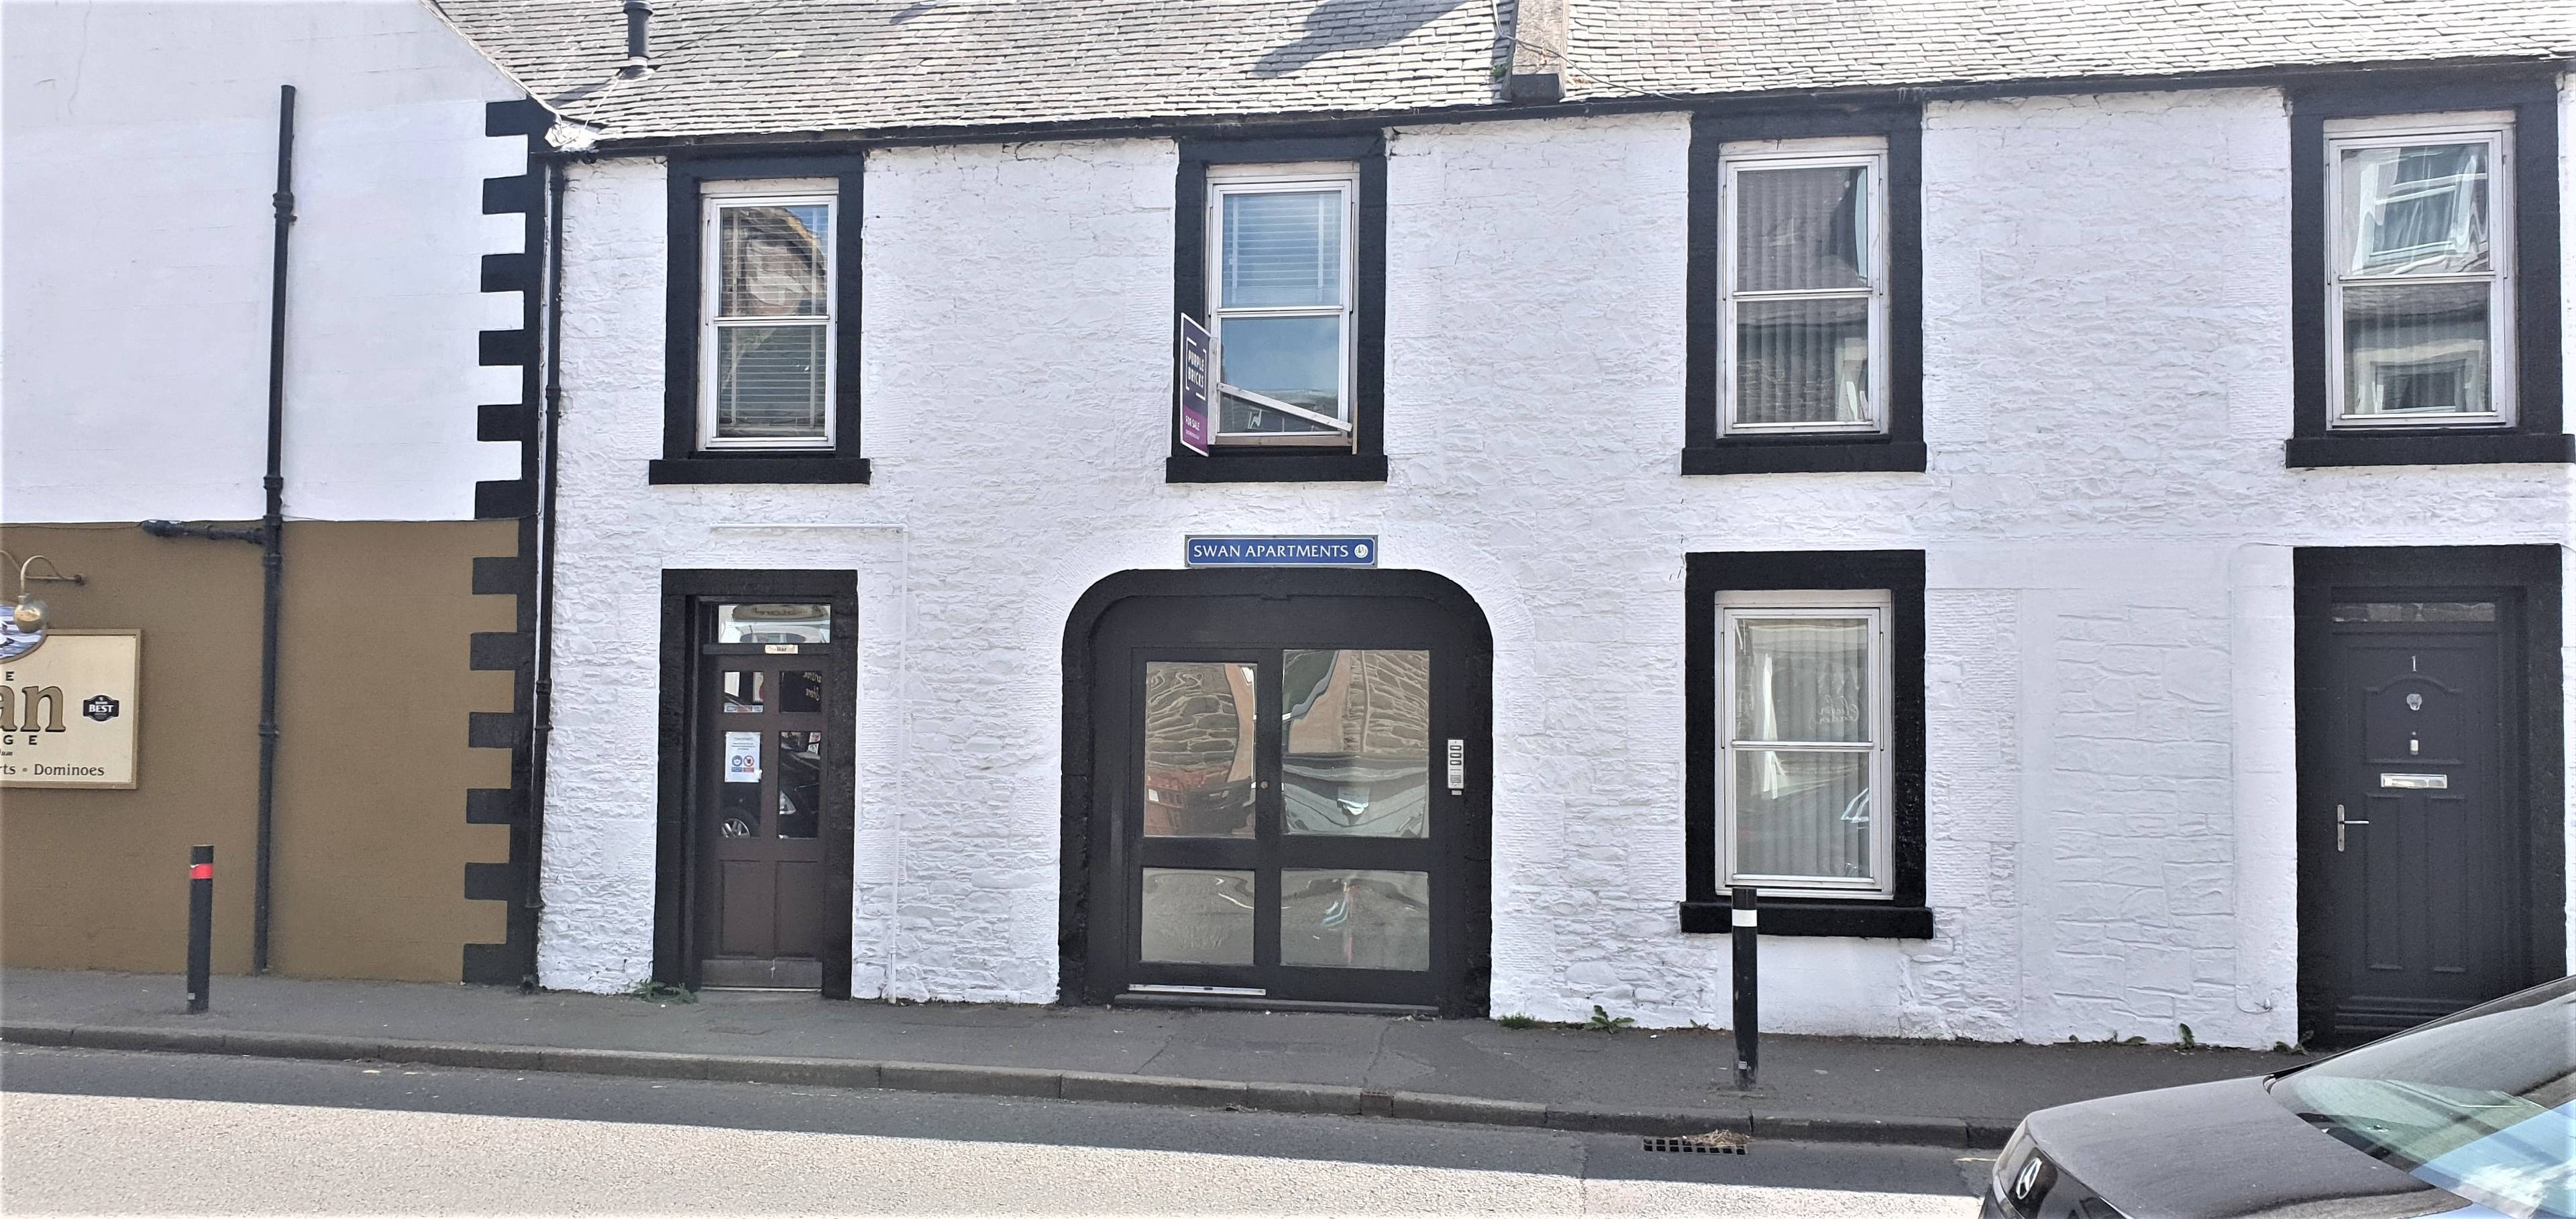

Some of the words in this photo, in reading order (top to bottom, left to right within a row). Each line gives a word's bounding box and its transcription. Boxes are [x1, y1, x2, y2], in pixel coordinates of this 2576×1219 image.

[1188, 350, 1204, 372] PURPLE
[1187, 368, 1204, 388] BRICKS
[1192, 419, 1200, 431] SALE
[1193, 545, 1240, 558] SWAN
[1245, 545, 1348, 558] APARTMENTS
[2411, 655, 2417, 672] 1
[89, 704, 114, 712] BEST
[34, 763, 105, 776] Dominoes
